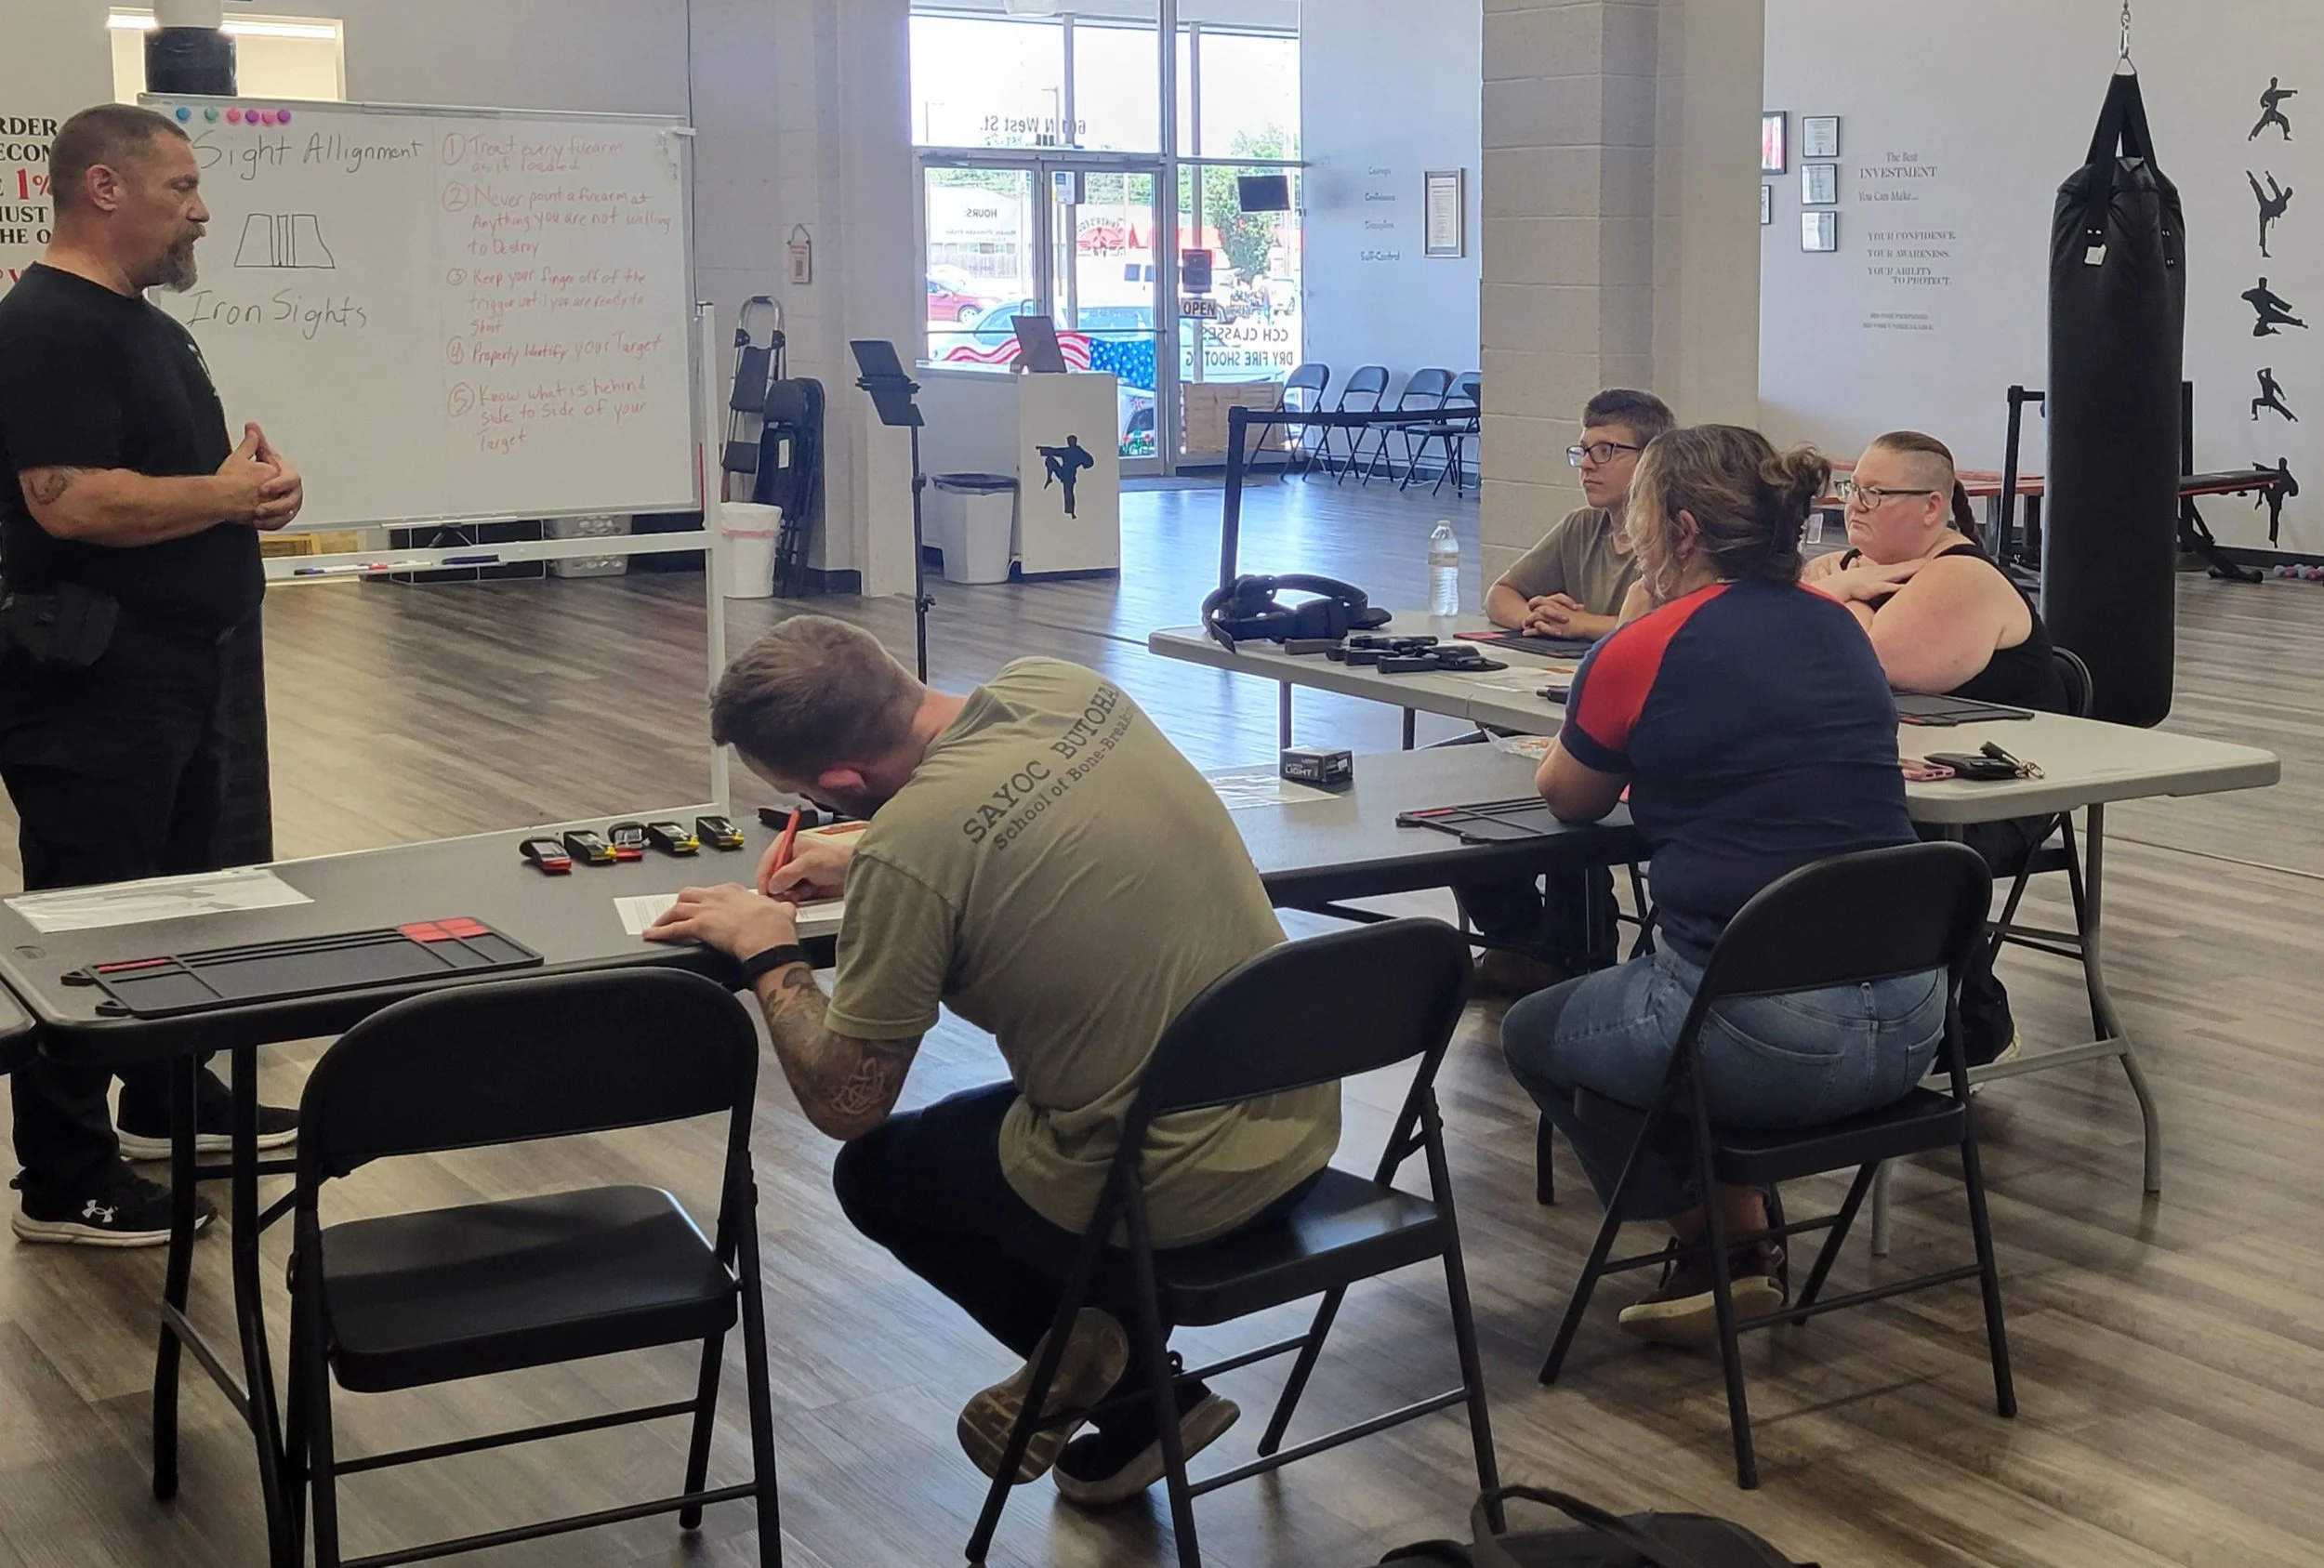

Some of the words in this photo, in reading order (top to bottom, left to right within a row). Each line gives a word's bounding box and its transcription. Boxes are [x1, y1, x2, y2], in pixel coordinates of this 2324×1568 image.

[468, 134, 518, 156] Treat
[568, 135, 624, 156] firearm
[191, 129, 293, 180] Sight
[303, 132, 424, 174] Allignment
[471, 163, 490, 174] as
[496, 156, 511, 174] if
[1860, 166, 1937, 178] INVESTMENT
[473, 184, 525, 208] Never
[530, 186, 562, 210] point
[578, 187, 627, 204] firearm
[0, 206, 48, 223] UST
[472, 209, 530, 236] Anything
[534, 211, 561, 230] you
[565, 212, 587, 226] are
[592, 206, 619, 224] not
[1868, 231, 1894, 241] YOUR
[468, 239, 487, 256] to
[1867, 249, 1894, 257] YOUR
[473, 269, 503, 287] Keep
[623, 269, 645, 284] the
[1868, 267, 1894, 275] YOUR
[1895, 267, 1932, 275] ABILITY
[1892, 276, 1905, 284] TO
[187, 289, 261, 327] Iron
[272, 287, 367, 339] Sights
[1182, 301, 1216, 316] OPEN
[612, 331, 664, 360] Target
[479, 384, 521, 406] Know
[528, 384, 563, 401] what
[571, 385, 588, 398] is
[519, 404, 535, 418] to
[584, 399, 608, 415] of
[614, 402, 647, 425] your
[1285, 766, 1313, 777] LIGHT
[962, 760, 1050, 844] SAYOC
[993, 793, 1051, 850] School
[1050, 777, 1069, 797] of
